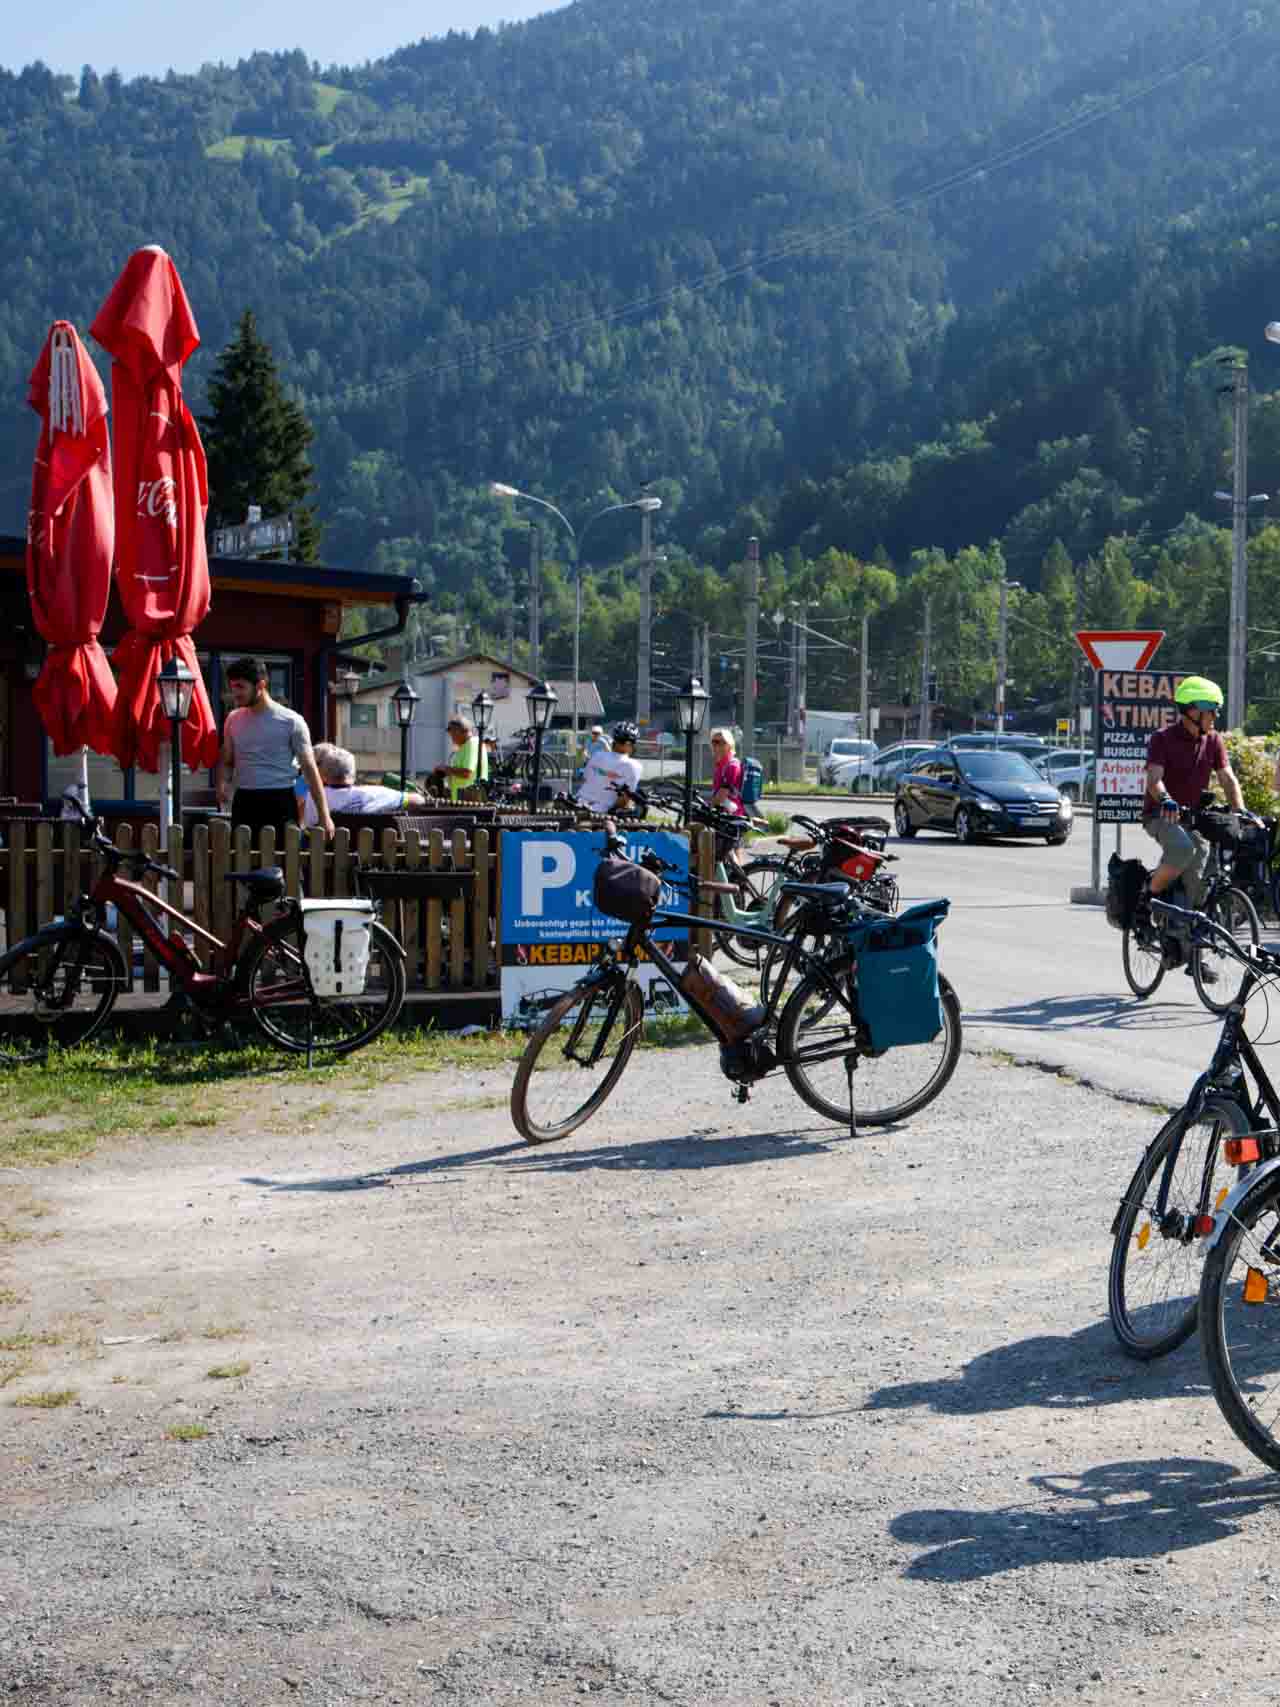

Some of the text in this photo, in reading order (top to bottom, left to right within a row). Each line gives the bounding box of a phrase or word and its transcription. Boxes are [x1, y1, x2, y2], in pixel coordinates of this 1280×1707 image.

[1115, 704, 1176, 729] TIME
[1103, 732, 1136, 744] PIZZA
[521, 841, 576, 915] P
